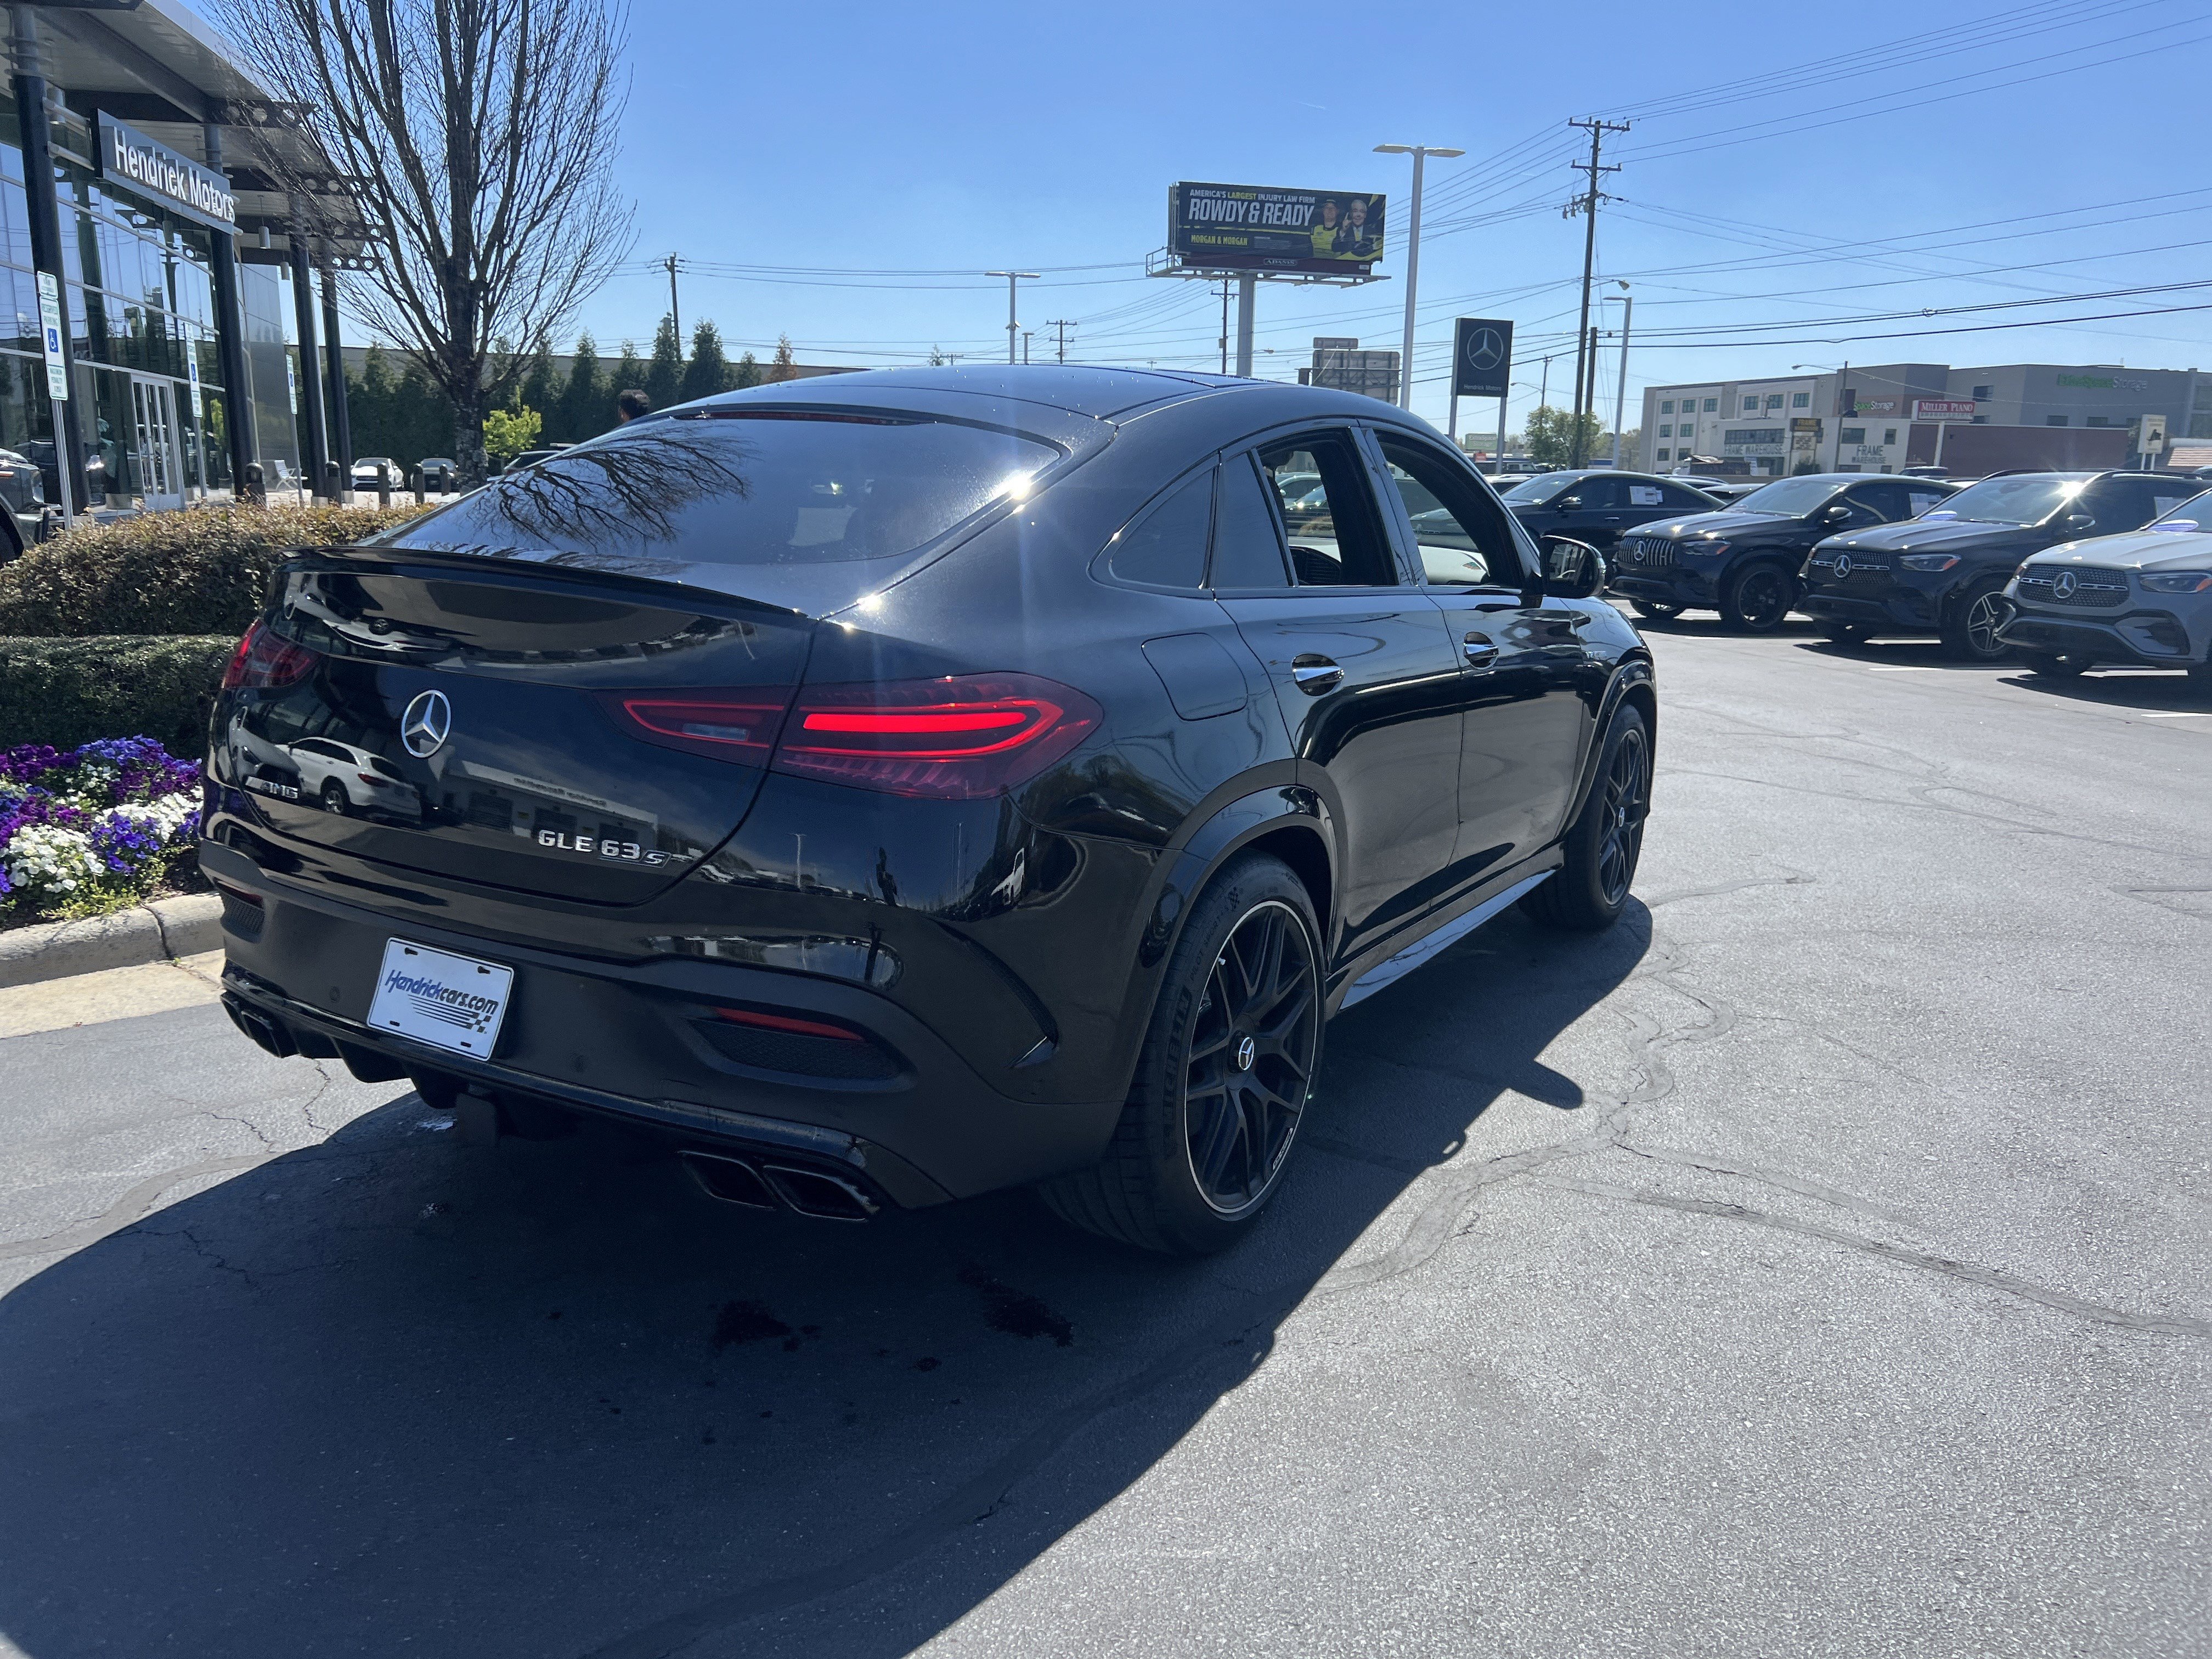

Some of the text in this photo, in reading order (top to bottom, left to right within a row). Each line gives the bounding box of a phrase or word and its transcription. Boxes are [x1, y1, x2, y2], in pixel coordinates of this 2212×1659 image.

[114, 126, 235, 223] Hendrick Motors
[1189, 189, 1226, 198] AMERICA'S
[1258, 194, 1283, 202] INJURY
[1188, 199, 1314, 226] ROWDY & READY
[1190, 235, 1216, 244] MORGAN
[1222, 236, 1248, 246] MORGAN
[1921, 402, 1973, 412] MILLER PIANO
[1724, 444, 1743, 455] FRAME
[1745, 443, 1783, 455] WAREHOUSE
[1857, 445, 1883, 456] FRAME
[538, 830, 593, 853] GLE
[601, 839, 640, 860] 63
[385, 969, 499, 1015] Hendrickcars.com
[1163, 993, 1190, 1124] MICHELIN
